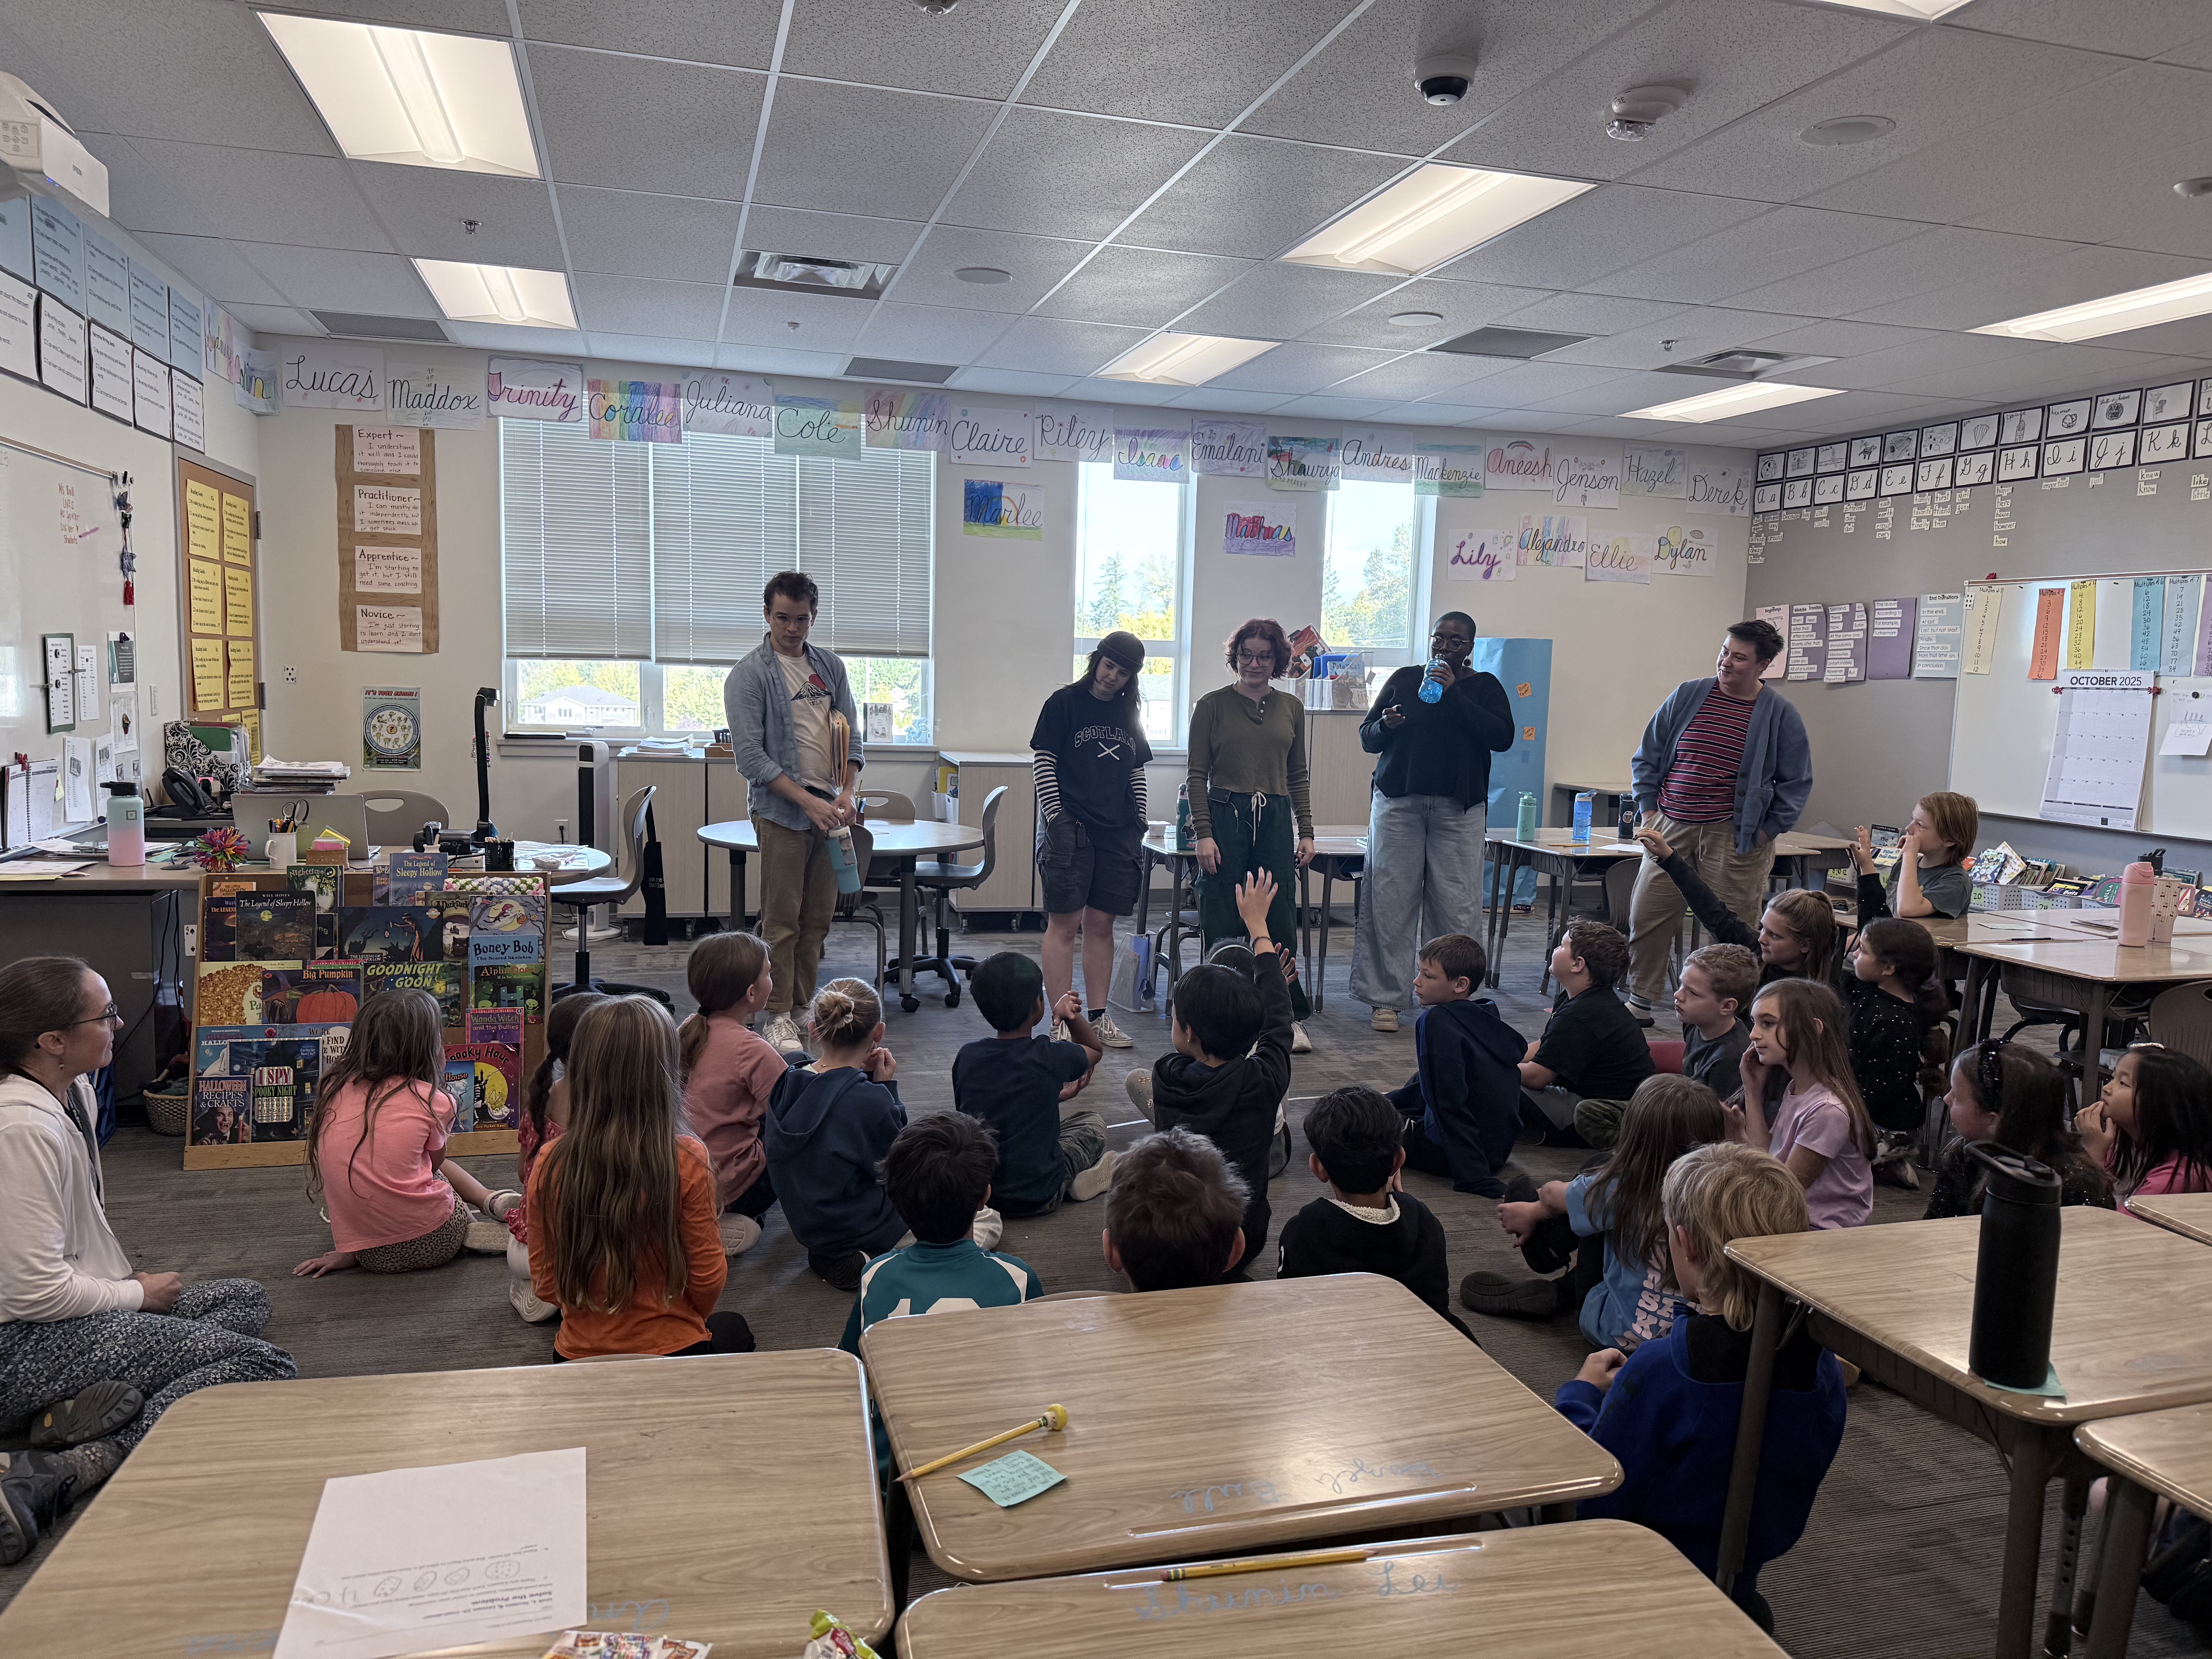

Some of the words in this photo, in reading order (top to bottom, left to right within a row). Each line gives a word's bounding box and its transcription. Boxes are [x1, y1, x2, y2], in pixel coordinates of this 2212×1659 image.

[286, 355, 378, 398] Lucas
[387, 378, 480, 410] Maddox
[488, 372, 579, 421] Trinity
[686, 381, 772, 423] Juliana
[589, 393, 678, 428] Coralee
[867, 400, 950, 435] Shunin
[777, 408, 845, 443] Cole
[358, 429, 392, 440] Expert
[951, 421, 1027, 453] Claire
[1035, 415, 1109, 461] Riley
[2147, 431, 2161, 452] K
[2166, 429, 2181, 449] k
[1118, 437, 1183, 471] Isaac
[1192, 433, 1264, 464] Emalani
[1343, 440, 1410, 471] Andres
[2115, 442, 2126, 465] j
[1271, 445, 1339, 485] Shaurya
[1487, 448, 1553, 479] Aneesh
[2004, 453, 2015, 471] H
[2020, 451, 2030, 468] h
[1416, 457, 1481, 489] Mackenzie
[1557, 459, 1619, 501] Jenson
[1626, 456, 1676, 492] Hazel
[1935, 464, 1944, 487] f
[2090, 474, 2103, 487] just
[2141, 470, 2159, 479] knew
[2193, 476, 2207, 485] like
[1690, 475, 1747, 505] Derek
[2043, 478, 2068, 489] important
[2139, 483, 2155, 493] know
[1958, 492, 1969, 501] girl
[1997, 497, 2010, 506] here
[2193, 489, 2209, 499] little
[968, 493, 1043, 527] Marlee
[1934, 505, 1950, 514] friend
[1224, 513, 1292, 541] Mathias
[1912, 519, 1929, 528] finally
[1995, 521, 2015, 529] however
[1520, 528, 1584, 563] Alejandro
[1996, 536, 2006, 544] how
[359, 549, 409, 562] Apprentice
[1451, 541, 1501, 579] Lily
[1591, 544, 1638, 571] Ellie
[1655, 537, 1706, 568] Dylan
[361, 608, 394, 619] Novice
[2070, 676, 2117, 685] OCTOBER
[2119, 677, 2142, 686] 2025
[290, 868, 324, 878] Nighttime
[397, 868, 417, 878] Sleepy
[420, 867, 442, 876] Hollow
[322, 877, 335, 886] Dark
[251, 900, 269, 909] Legend
[270, 899, 276, 909] of
[276, 900, 292, 909] Sleepy
[441, 902, 455, 910] Dark
[473, 943, 511, 956] Boney
[513, 940, 533, 953] Bob
[303, 970, 316, 980] Big
[319, 970, 353, 979] Pumpkin
[367, 963, 443, 975] GOODNIGHT
[395, 977, 433, 988] GOON
[471, 1014, 496, 1023] Wanda
[497, 1014, 519, 1023] Witch
[485, 1046, 509, 1063] Hour
[259, 1070, 263, 1084] I
[268, 1069, 290, 1084] SPY
[445, 1073, 468, 1081] House
[199, 1080, 247, 1092] HALLOWEEN
[252, 1086, 276, 1096] SPOOKY
[277, 1085, 297, 1096] NIGHT
[1134, 1579, 1341, 1623] Shunin
